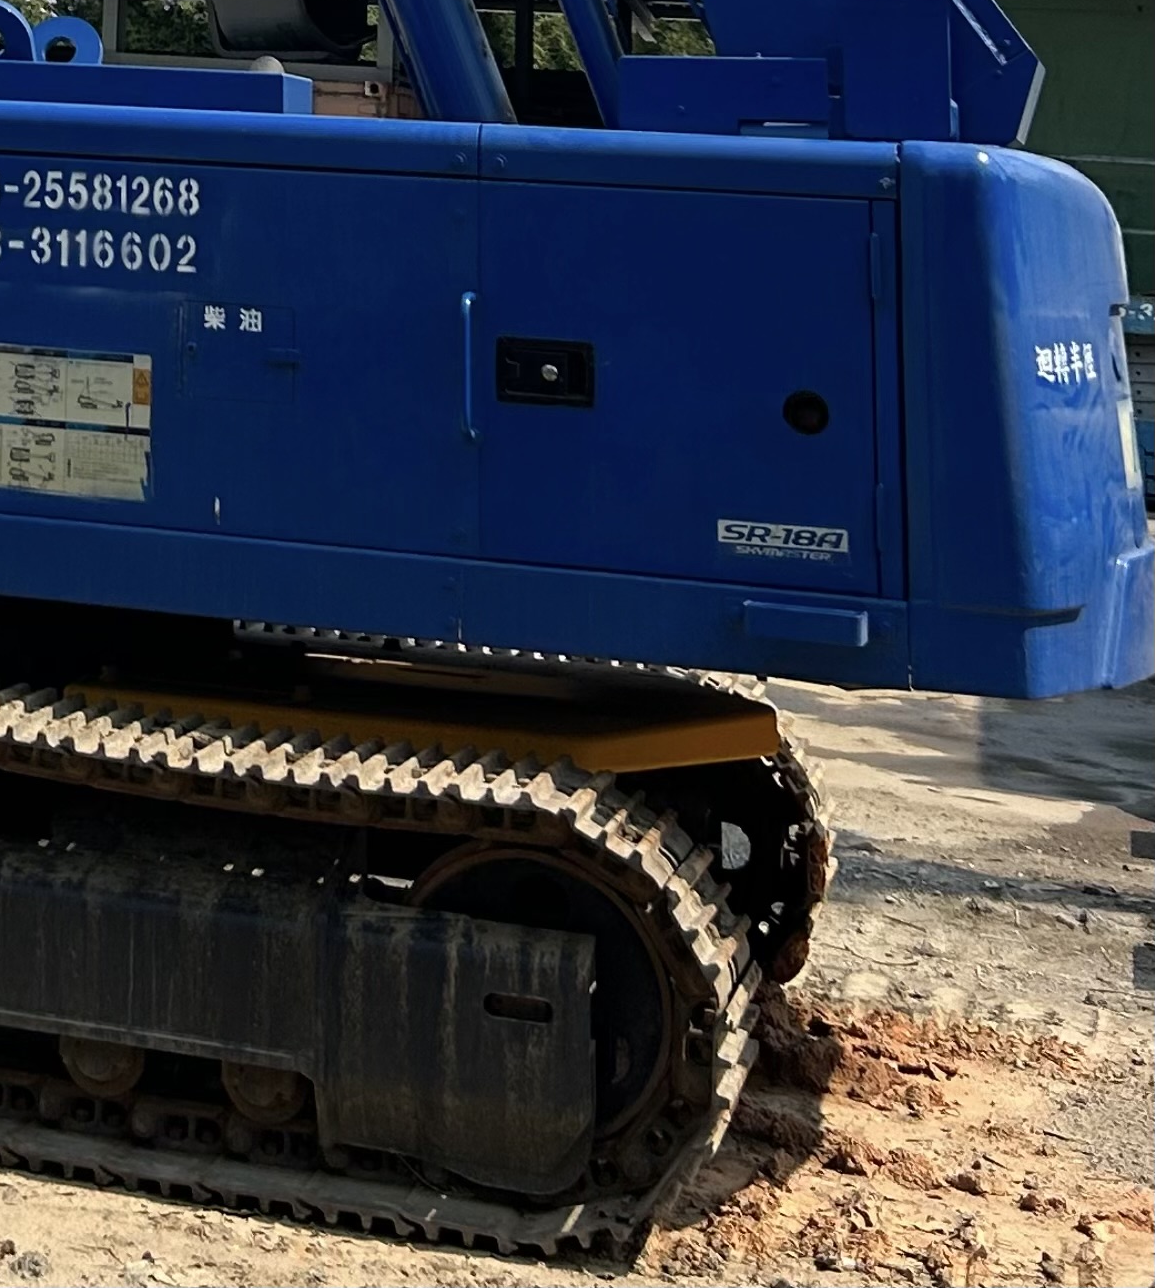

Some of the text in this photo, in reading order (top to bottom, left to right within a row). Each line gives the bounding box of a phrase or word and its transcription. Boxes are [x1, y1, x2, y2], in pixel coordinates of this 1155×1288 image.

[203, 305, 263, 333] 柴油
[721, 524, 844, 549] SR-18A
[735, 545, 831, 561] SKYMASTER
